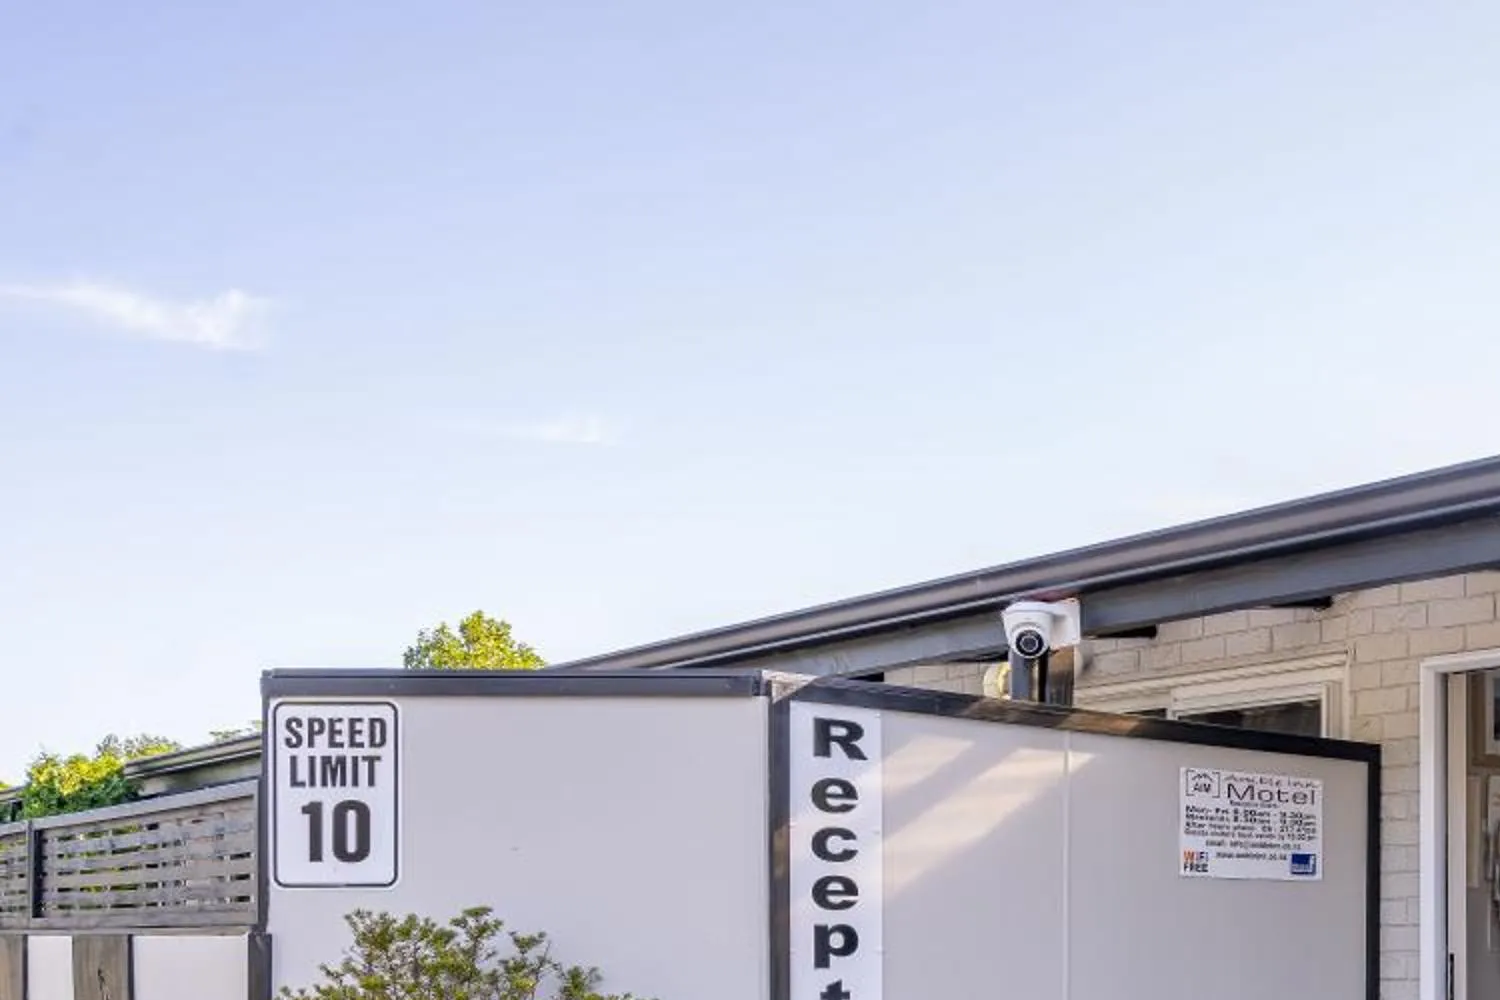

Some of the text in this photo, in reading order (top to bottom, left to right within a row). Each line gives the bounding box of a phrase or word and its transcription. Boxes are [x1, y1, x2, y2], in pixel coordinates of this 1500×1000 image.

[284, 716, 387, 749] SPEED
[289, 755, 382, 788] LIMIT
[1227, 783, 1314, 805] Motel
[301, 799, 371, 863] 10
[1183, 862, 1209, 873] FREE
